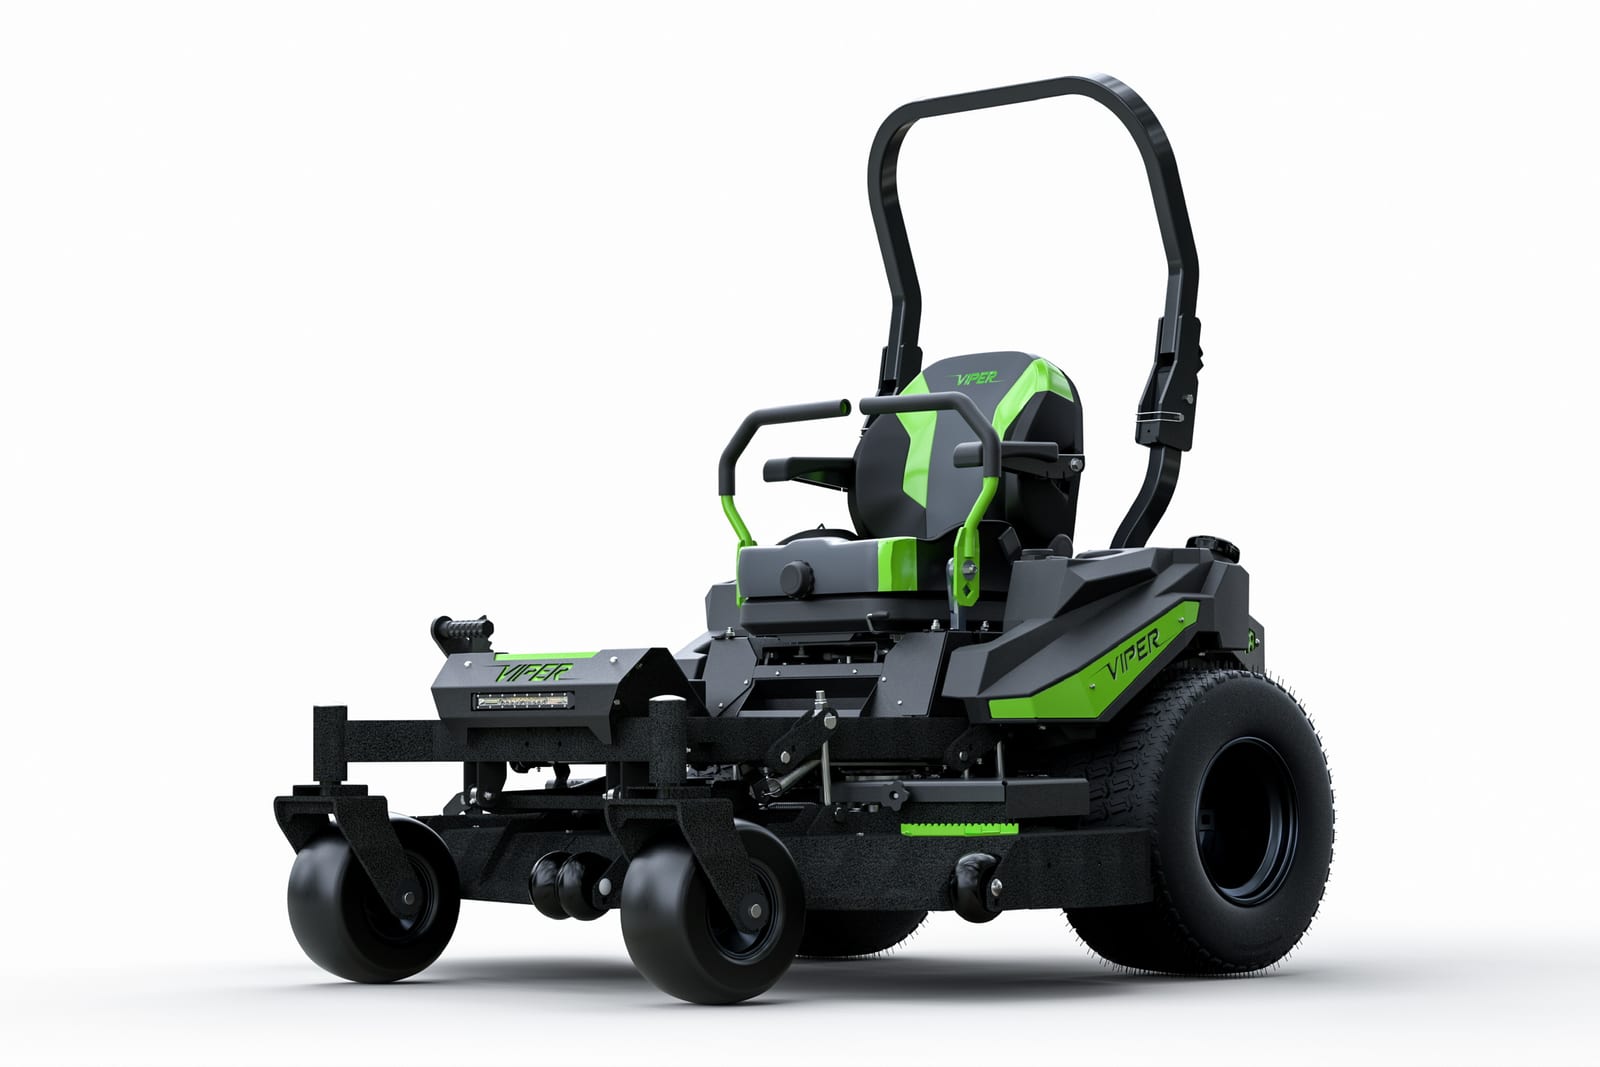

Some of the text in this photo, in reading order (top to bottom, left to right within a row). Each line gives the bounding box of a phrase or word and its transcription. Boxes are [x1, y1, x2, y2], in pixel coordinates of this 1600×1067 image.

[956, 370, 998, 386] VIPER
[1106, 628, 1159, 680] VIPER
[494, 662, 575, 682] VIPER
